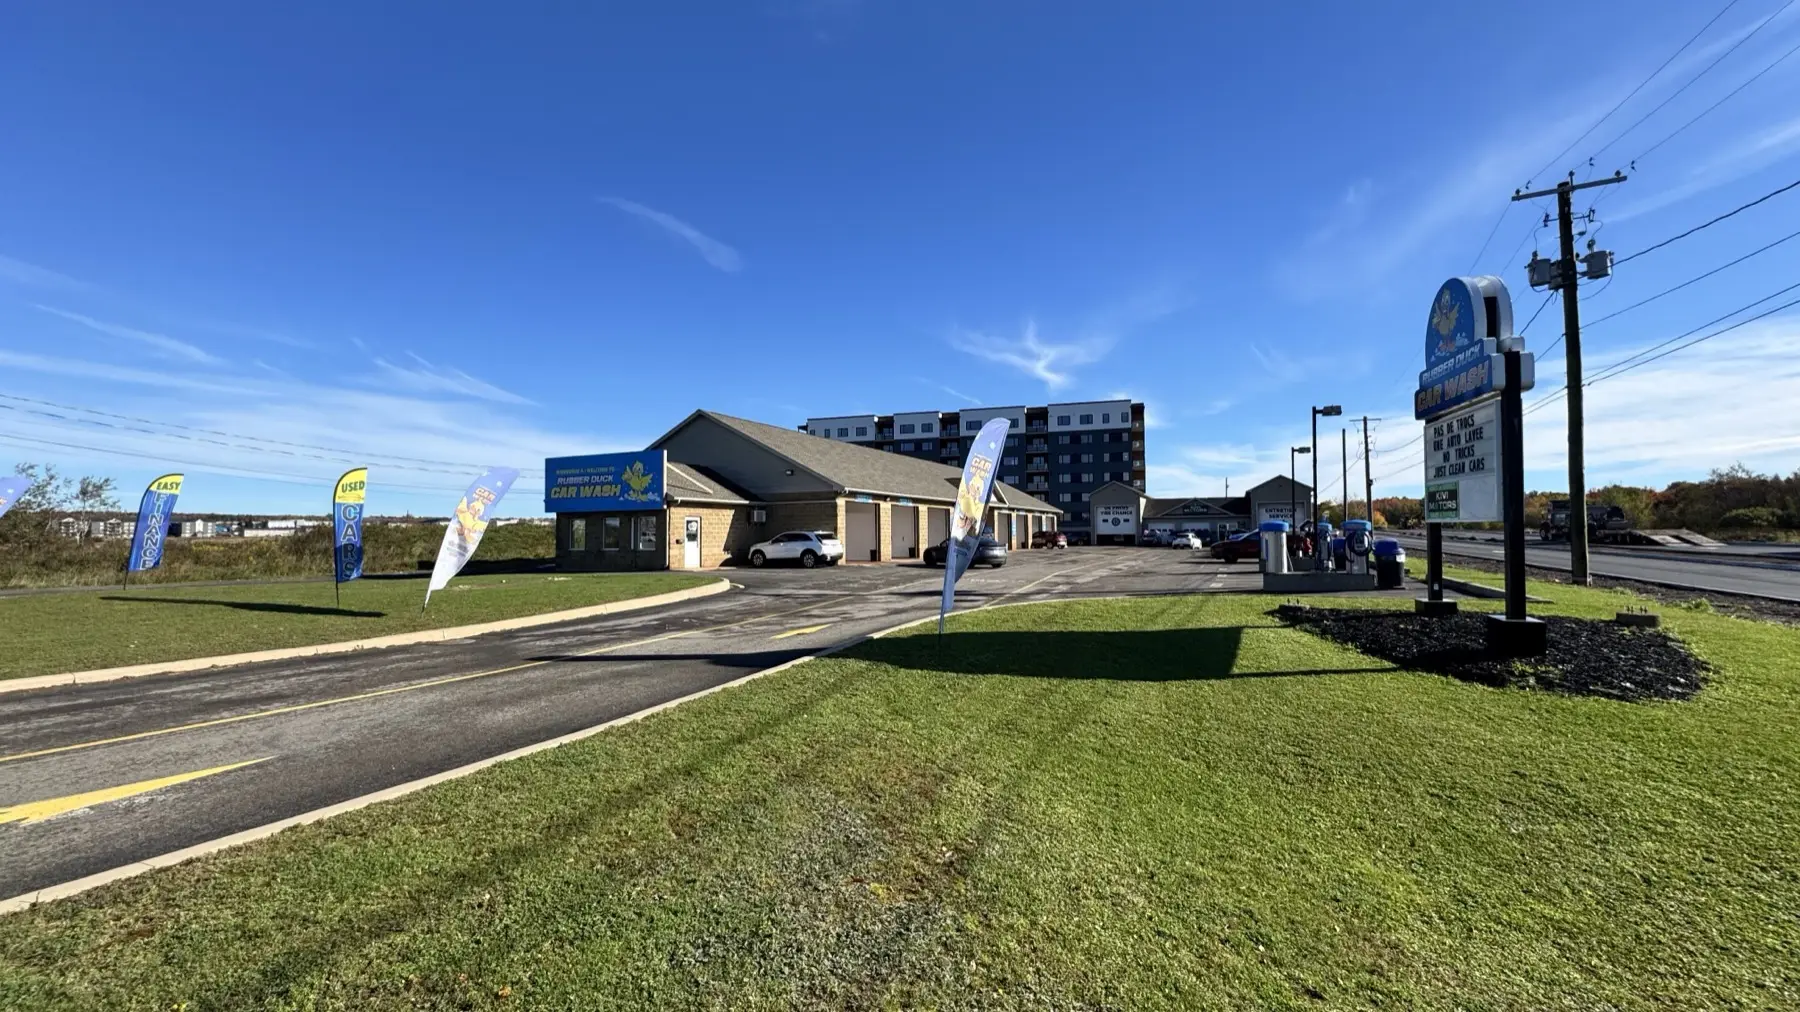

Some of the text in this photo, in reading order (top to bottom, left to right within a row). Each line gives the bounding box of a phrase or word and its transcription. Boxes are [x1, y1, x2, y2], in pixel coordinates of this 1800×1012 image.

[1422, 343, 1481, 385] RUBBER DUCK
[1417, 360, 1489, 412] CAR WASH
[1433, 424, 1444, 439] PAS
[1446, 421, 1454, 434] DE
[1433, 426, 1484, 452] UNE AUTO LAVEE
[1443, 444, 1475, 463] NO TRICKS
[972, 457, 992, 472] CAR
[1433, 457, 1485, 478] JUST CLEAN CARS
[156, 481, 181, 491] EASY
[341, 480, 365, 493] USED
[557, 474, 614, 485] RUBBER DUCK
[551, 484, 621, 498] CAR WASH
[1435, 491, 1449, 500] KIVI
[140, 491, 170, 571] FINANCE
[341, 503, 360, 580] CARS
